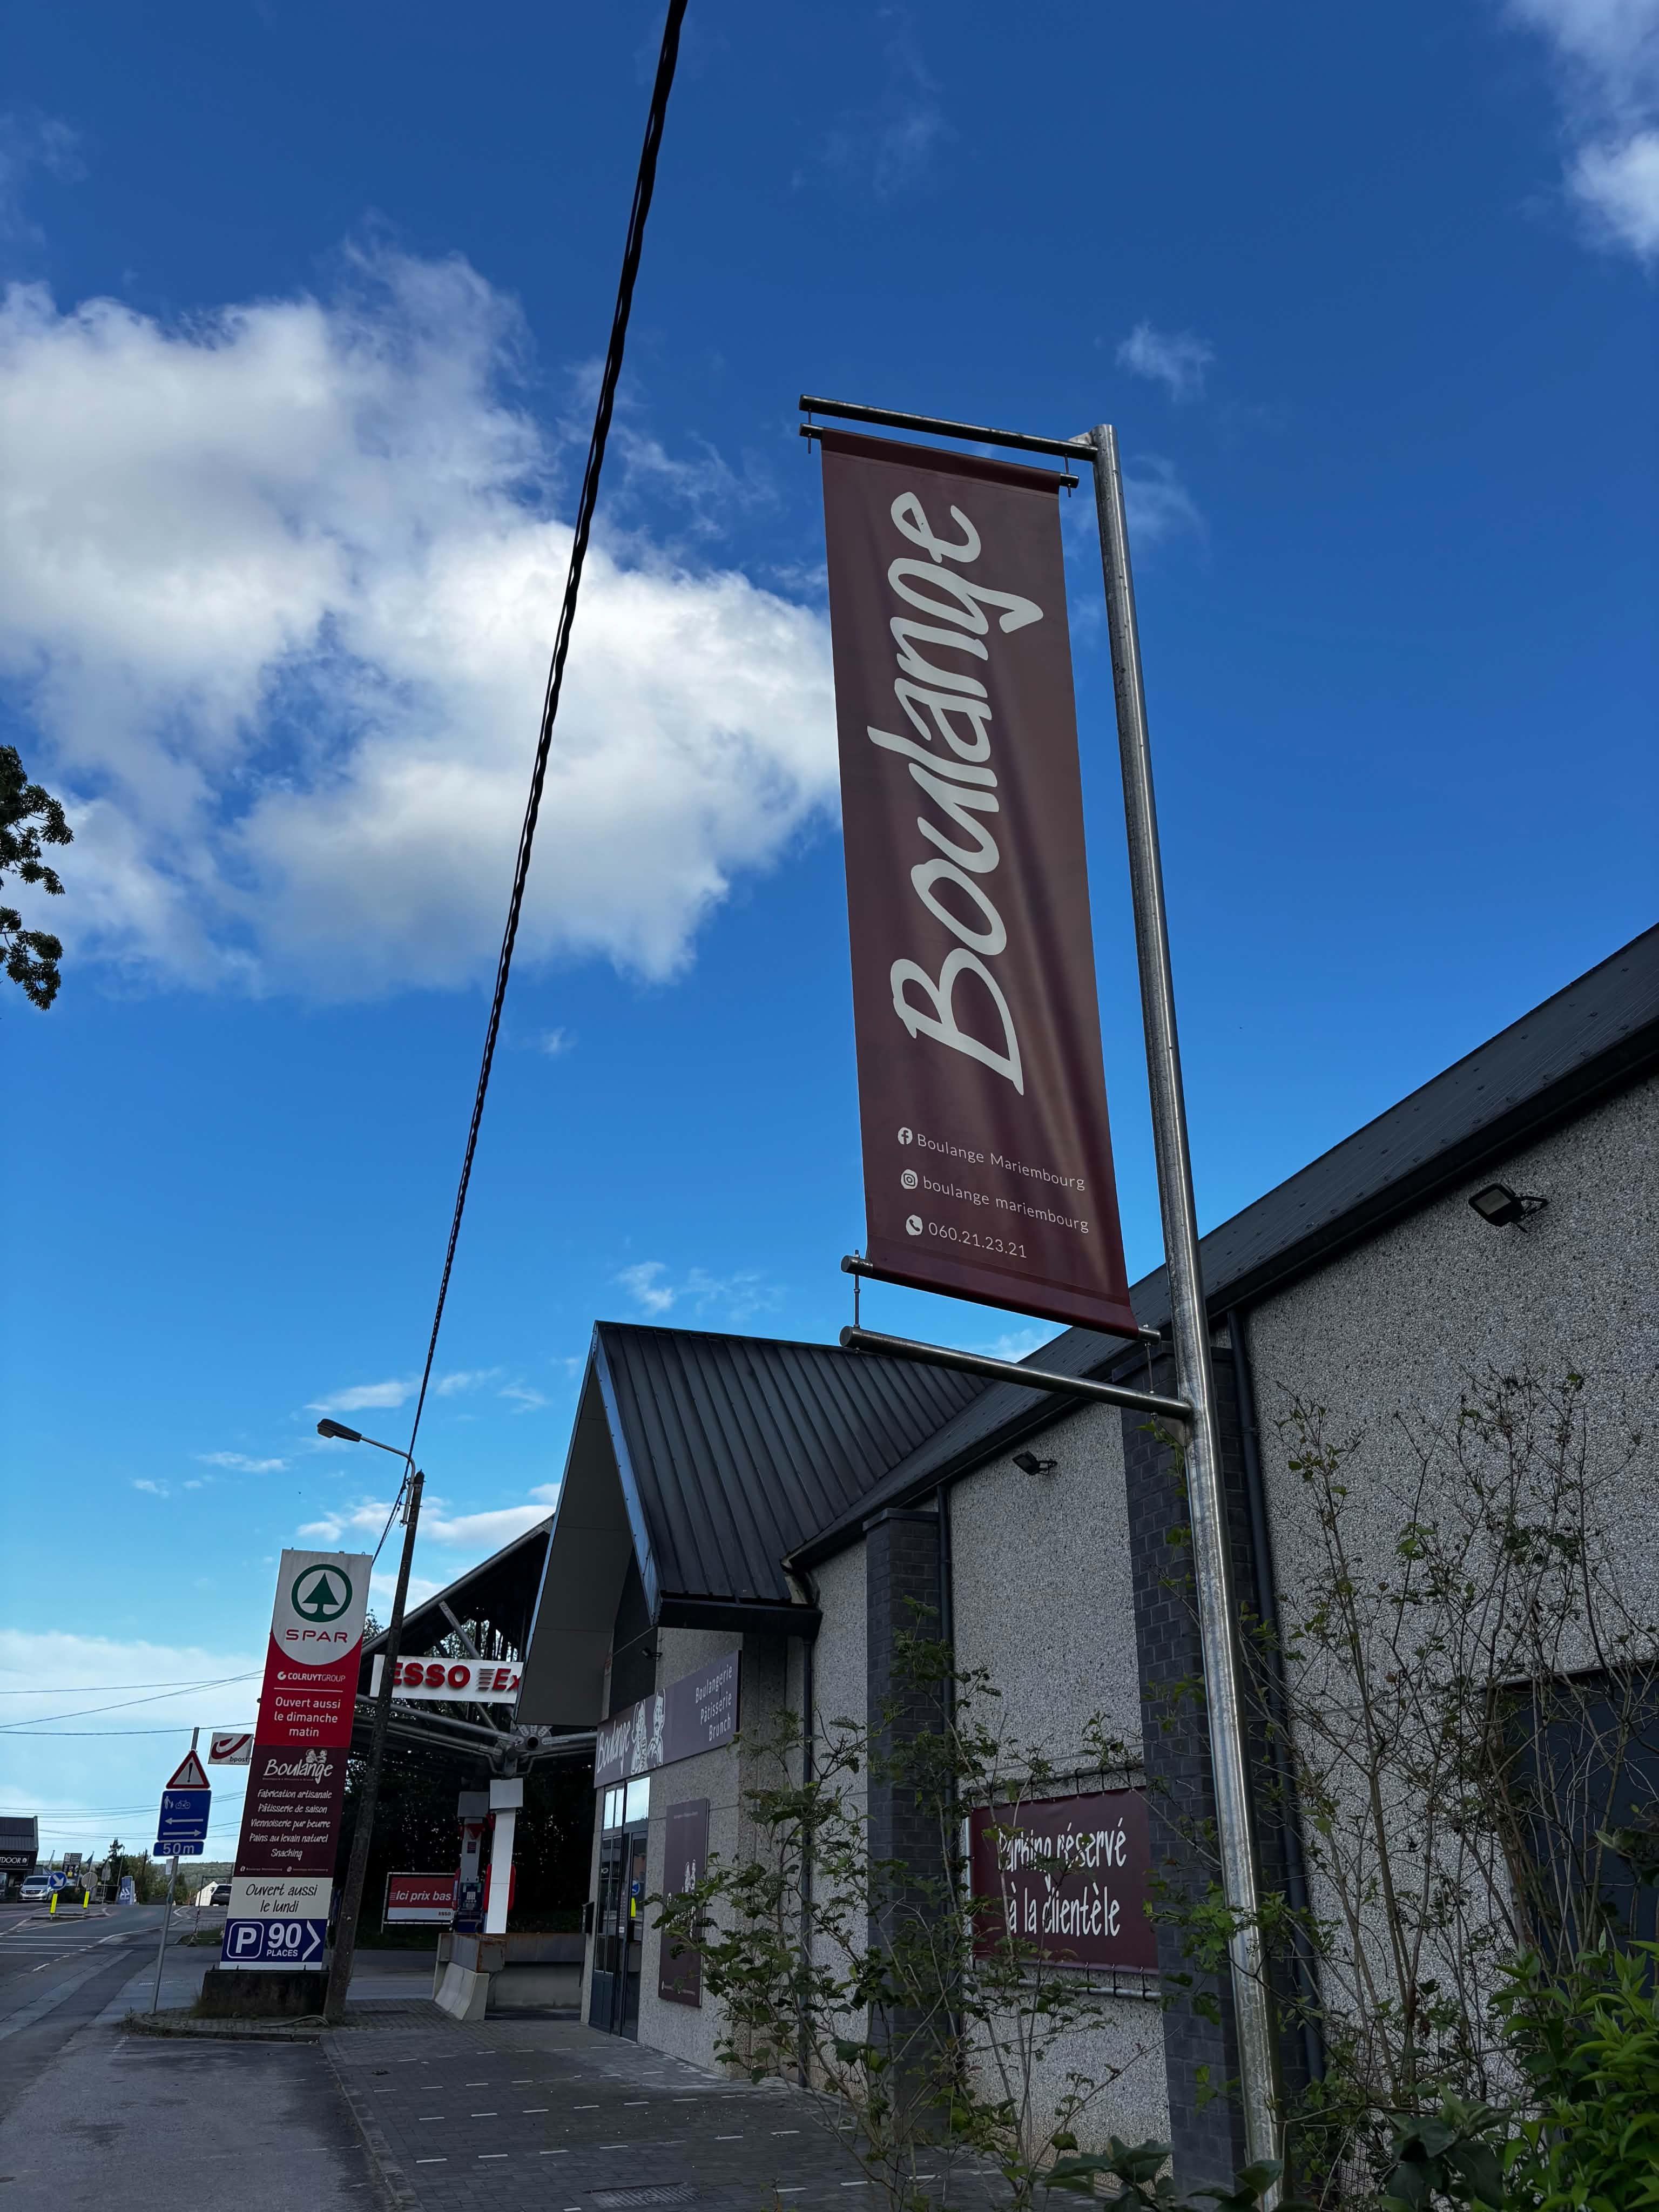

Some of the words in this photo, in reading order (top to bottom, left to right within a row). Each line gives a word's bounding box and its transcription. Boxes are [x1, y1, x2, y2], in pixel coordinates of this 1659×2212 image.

[867, 491, 1043, 1096] Boulange
[917, 1133, 984, 1163] Boulange
[990, 1152, 1085, 1191] Mariembourg
[923, 1175, 990, 1205] boulange
[995, 1197, 1089, 1233] mariembourg
[928, 1222, 1027, 1258] 060.21.23.21
[286, 1629, 348, 1643] SPAR
[393, 1662, 471, 1688] ESSO
[696, 1664, 732, 1704] Boulangerie
[275, 1697, 311, 1709] Ouvert
[313, 1699, 341, 1709] aussi
[700, 1691, 732, 1725] Pâtisserie
[274, 1711, 284, 1721] le
[286, 1711, 339, 1724] dimanche
[289, 1727, 320, 1737] matin
[709, 1712, 731, 1742] Brunch
[597, 1719, 631, 1776] Boulange
[263, 1758, 334, 1784] Boulange
[258, 1789, 296, 1798] Fabrication
[297, 1790, 333, 1799] artisanale
[258, 1803, 293, 1813] Pâtisserie
[294, 1804, 303, 1813] de
[305, 1805, 328, 1813] saison
[251, 1818, 292, 1828] Viennoiserie
[292, 1822, 306, 1831] pur
[307, 1820, 331, 1828] beurre
[249, 1832, 268, 1843] Pains
[280, 1833, 300, 1843] levain
[301, 1833, 328, 1843] naturel
[271, 1849, 303, 1861] Snacking
[246, 1884, 285, 1896] Ouvert
[288, 1884, 318, 1896] aussi
[396, 1891, 409, 1900] Ici
[410, 1891, 430, 1902] prix
[432, 1891, 452, 1901] bas
[260, 1900, 269, 1912] le
[272, 1900, 299, 1912] lundi
[1009, 1881, 1017, 1934] à
[1024, 1887, 1037, 1934] la
[1042, 1882, 1121, 1937] clientèle
[235, 1927, 257, 1953] P
[267, 1923, 302, 1948] 90
[266, 1949, 299, 1957] PLACES
